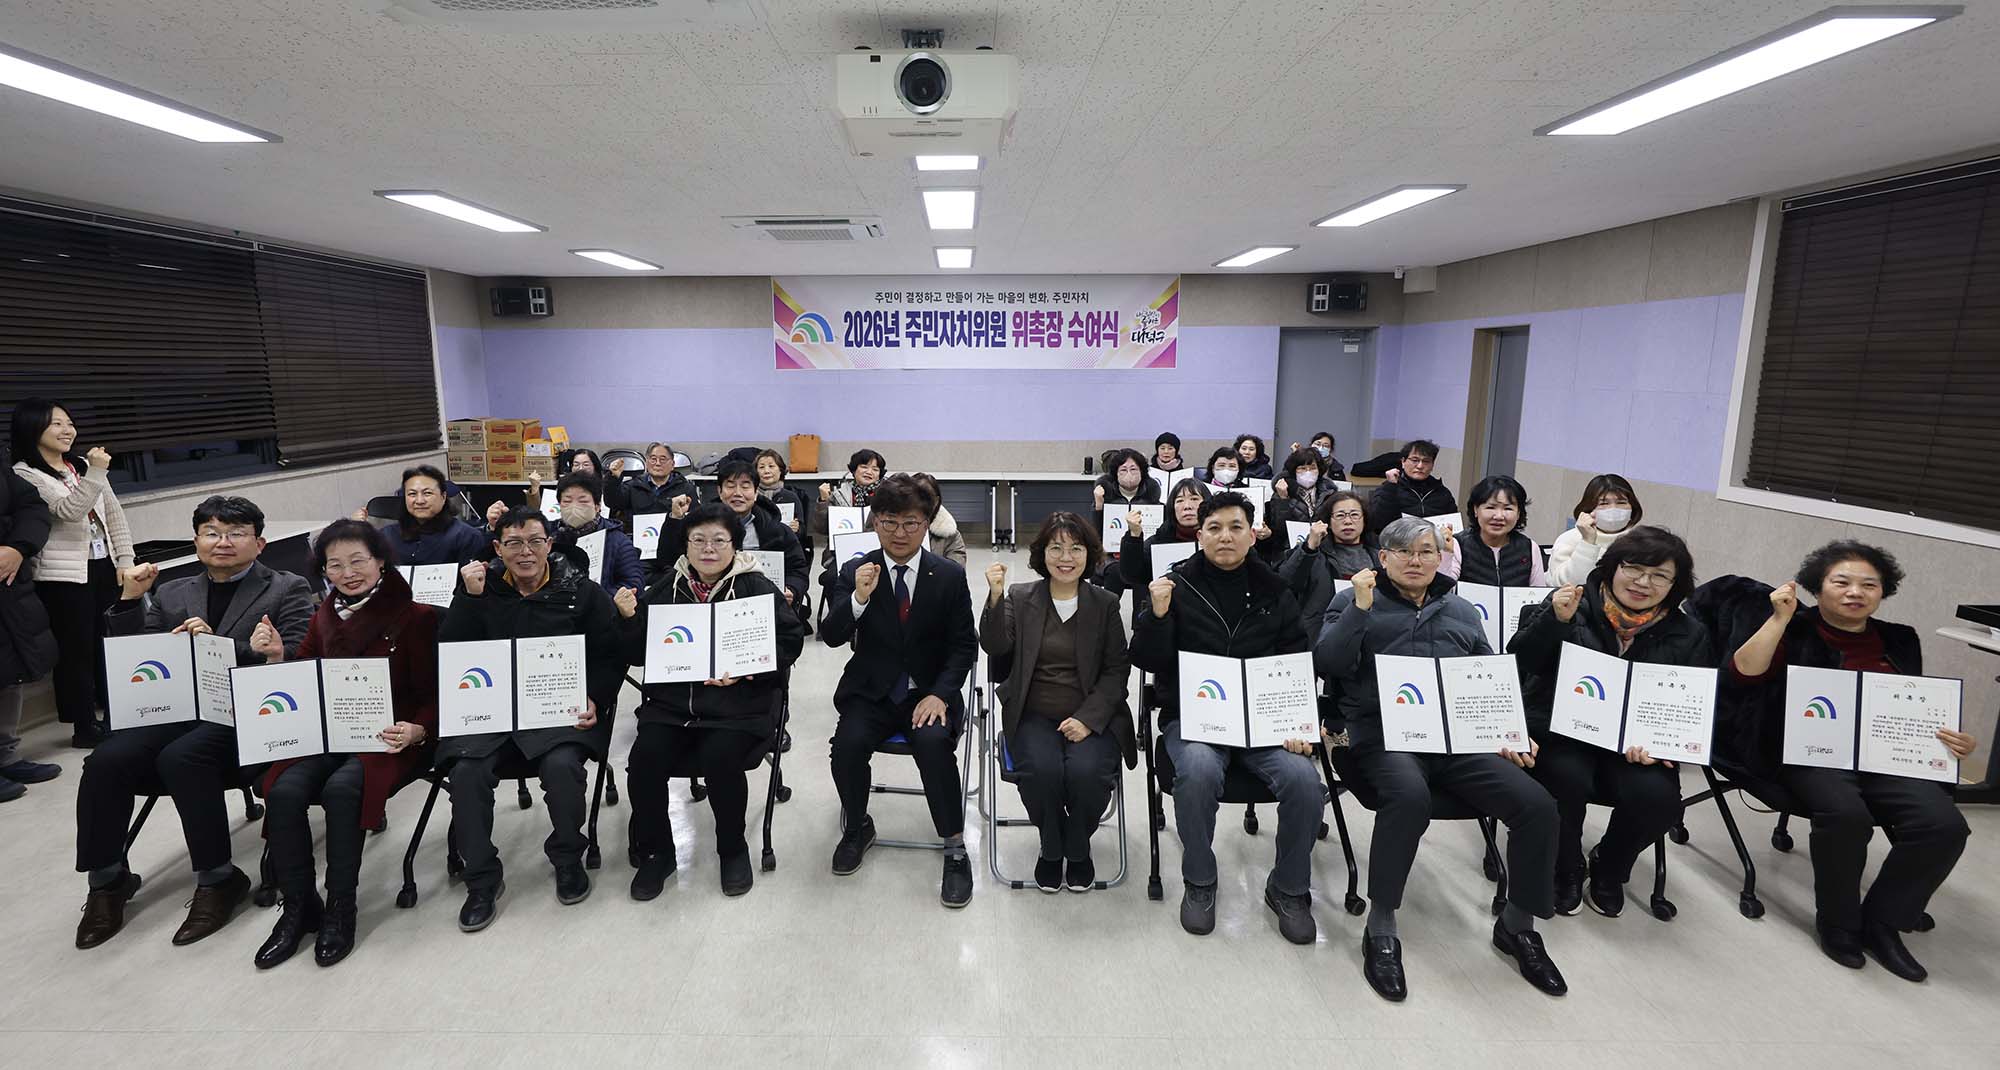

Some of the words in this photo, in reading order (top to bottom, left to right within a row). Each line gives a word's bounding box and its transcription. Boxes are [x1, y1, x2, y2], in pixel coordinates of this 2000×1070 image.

[874, 291, 902, 303] 주민이
[906, 291, 942, 303] 결정하고
[946, 291, 973, 303] 만들어
[976, 291, 994, 303] 가는
[998, 291, 1025, 303] 마을의
[1052, 291, 1089, 303] 주민자치
[843, 310, 900, 348] 2026년
[905, 310, 1007, 348] 주민자치위원
[1012, 310, 1063, 348] 위촉장
[1067, 309, 1119, 349] 수여식
[1131, 330, 1165, 344] 대덕구
